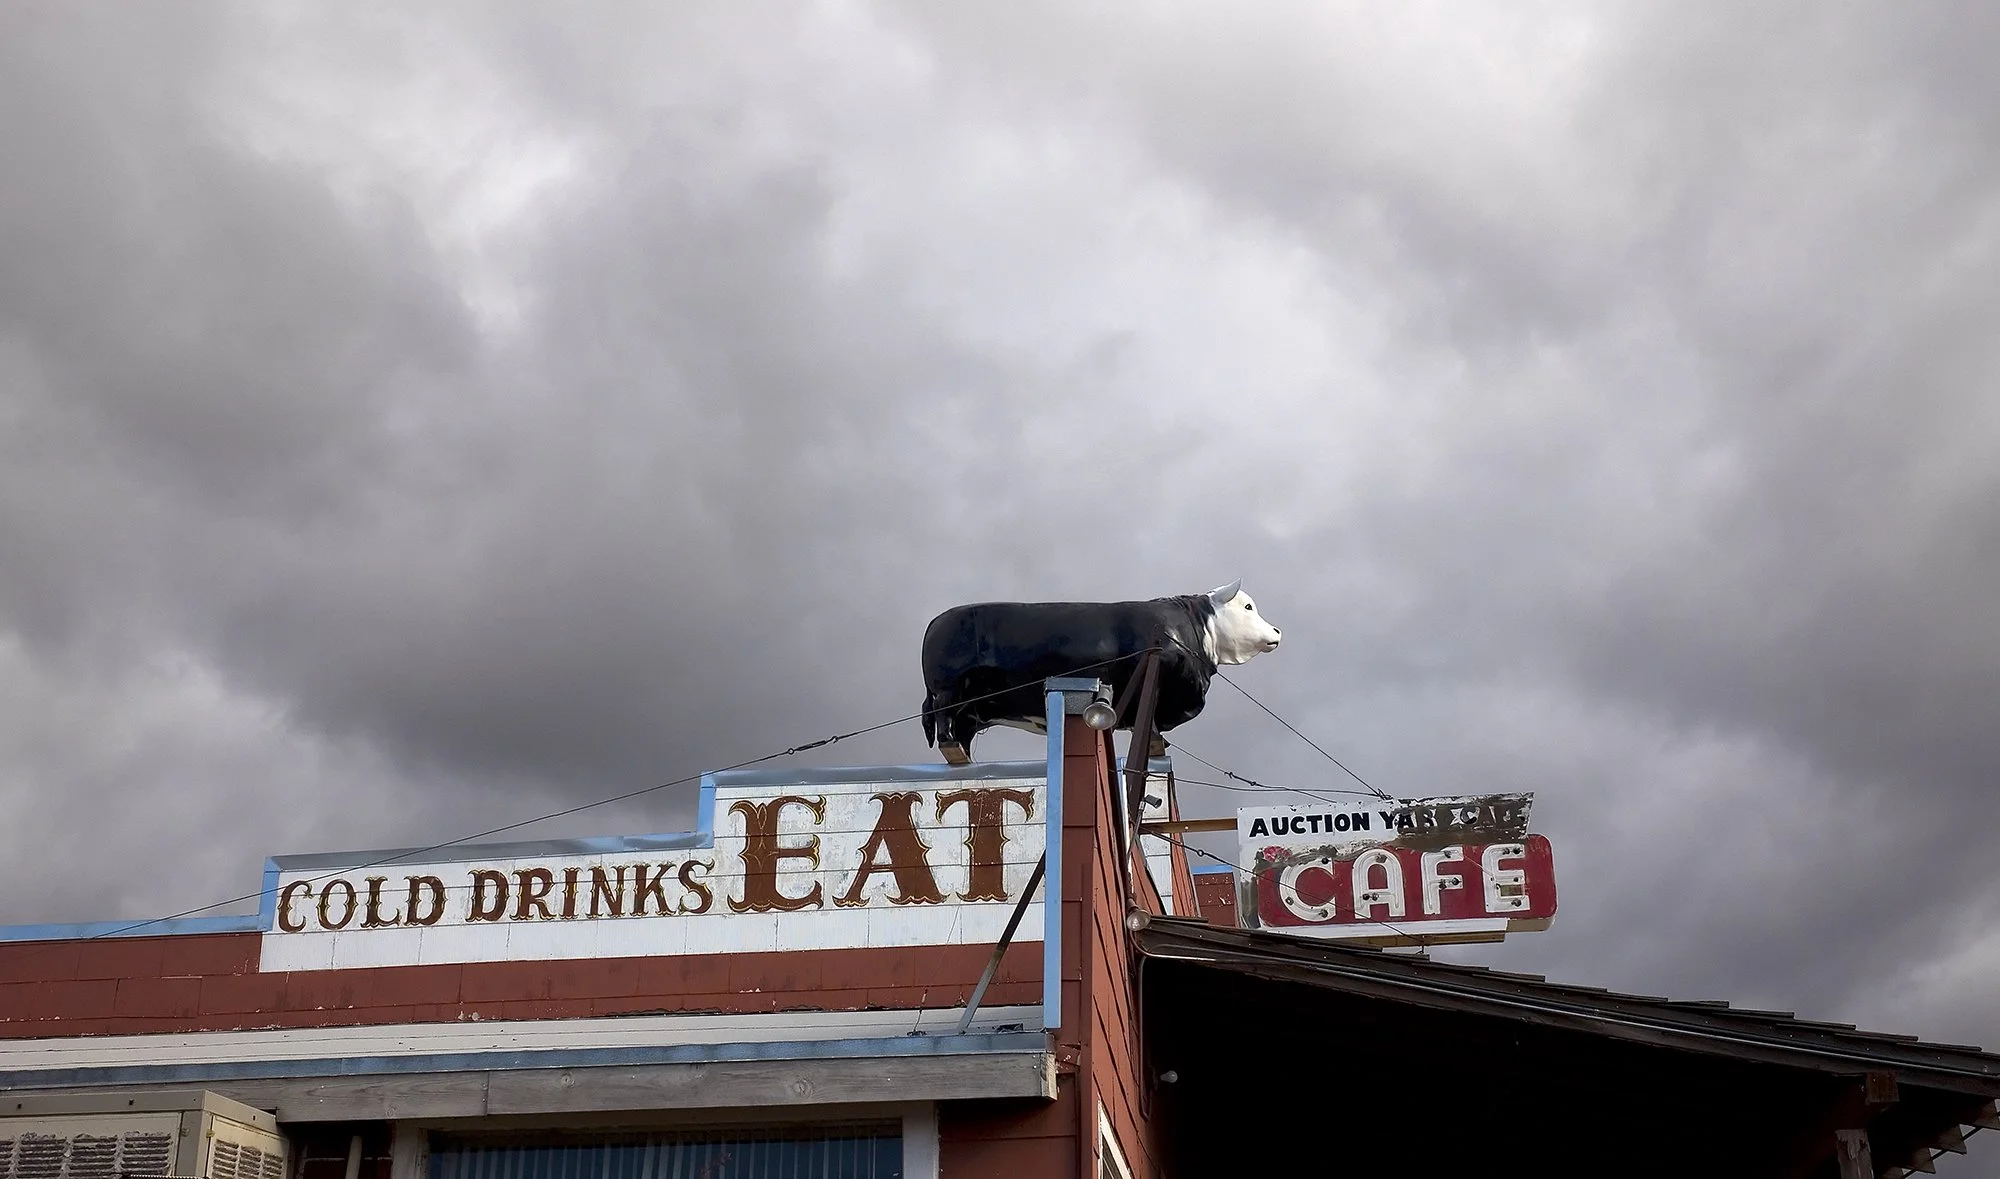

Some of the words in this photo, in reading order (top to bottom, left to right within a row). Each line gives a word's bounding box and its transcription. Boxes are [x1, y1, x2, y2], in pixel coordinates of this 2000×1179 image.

[277, 875, 448, 933] COLD
[465, 859, 716, 922] DRINKS
[727, 788, 1035, 911] EAT
[1249, 812, 1370, 837] AUCTION
[1379, 806, 1453, 831] YAR
[1279, 843, 1530, 922] CAFE
